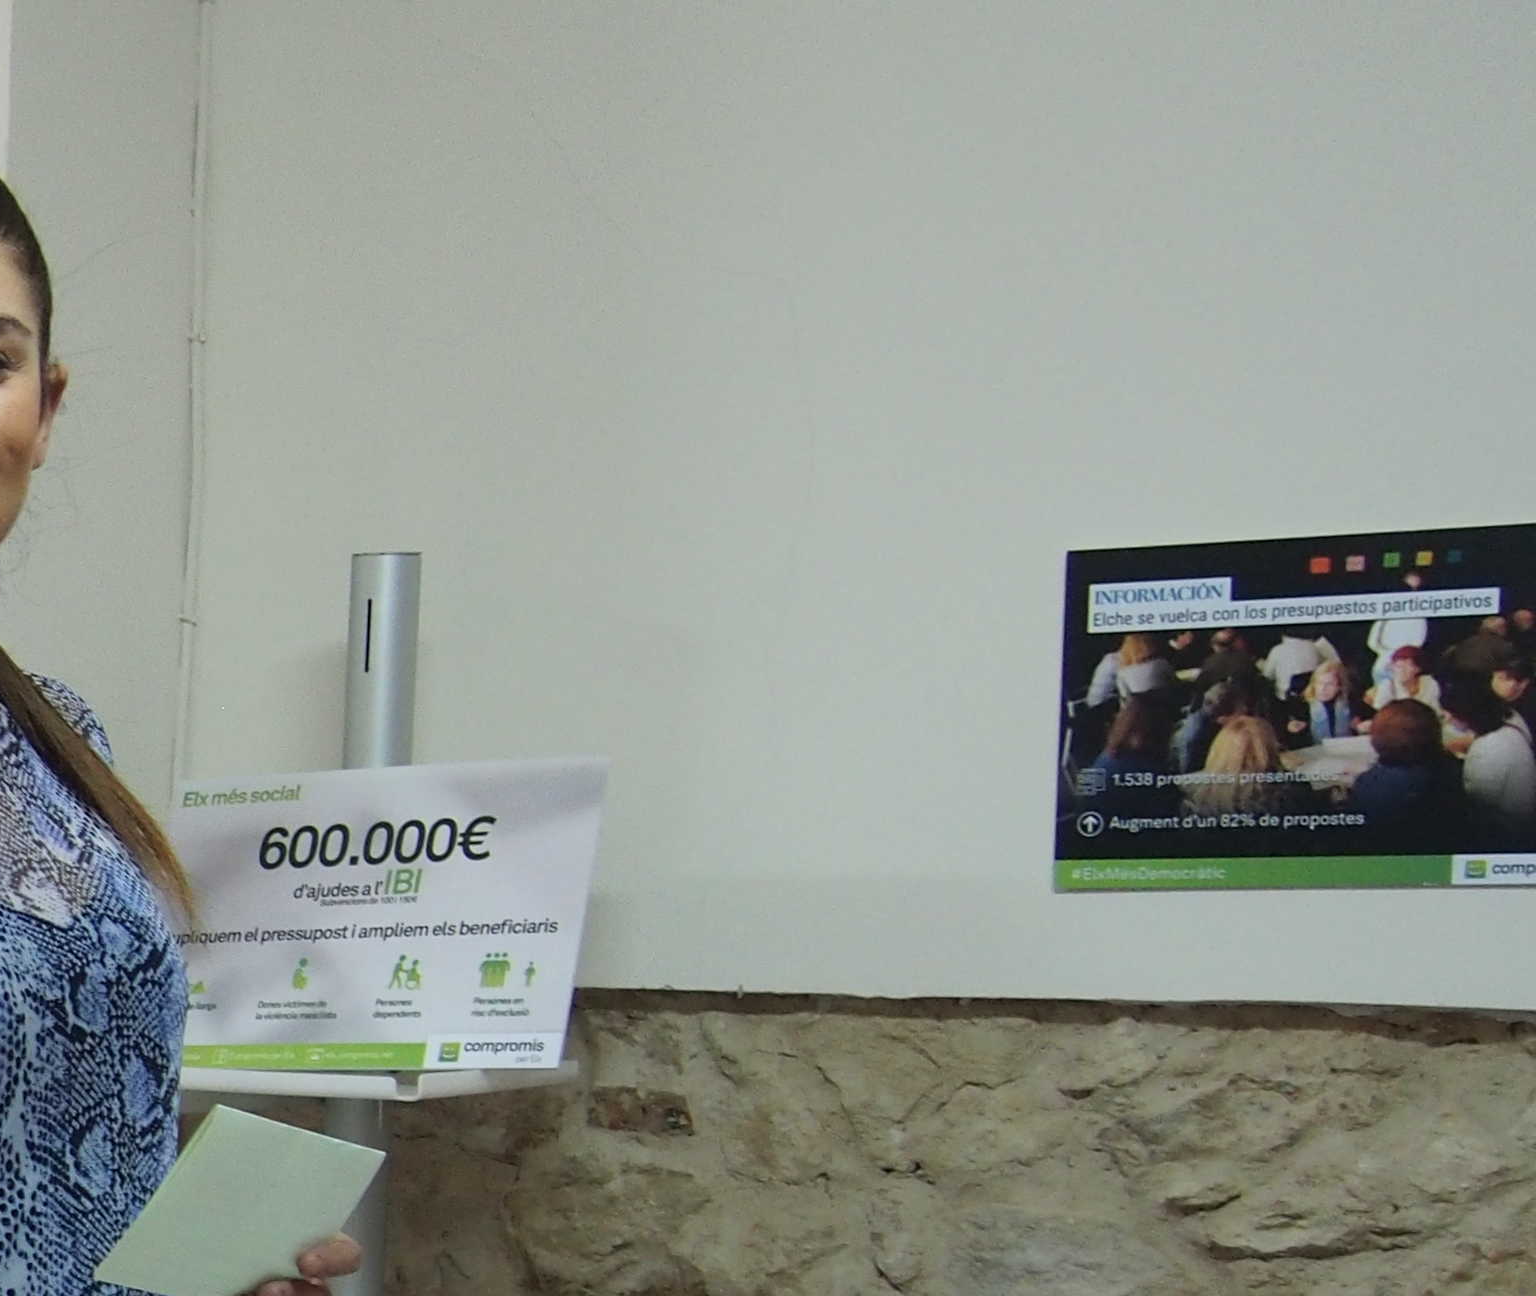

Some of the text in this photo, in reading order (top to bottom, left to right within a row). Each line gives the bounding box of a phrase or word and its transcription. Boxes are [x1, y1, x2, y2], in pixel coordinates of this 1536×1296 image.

[1094, 583, 1224, 605] INFORMACIÓN
[1093, 594, 1493, 627] Elche se vuelca con los presupuestos participativos
[1112, 770, 1340, 789] 1.538 propostes presentades
[182, 783, 301, 809] Elx més social
[1109, 812, 1365, 834] Augment d'un 82% de propostes
[258, 815, 497, 871] 600.000€
[293, 881, 359, 902] d'ajudes
[361, 884, 372, 897] a
[244, 926, 258, 943] el
[260, 925, 349, 946] pressupost
[358, 922, 429, 942] ampliem
[432, 920, 456, 937] els
[459, 917, 559, 936] beneficiaris
